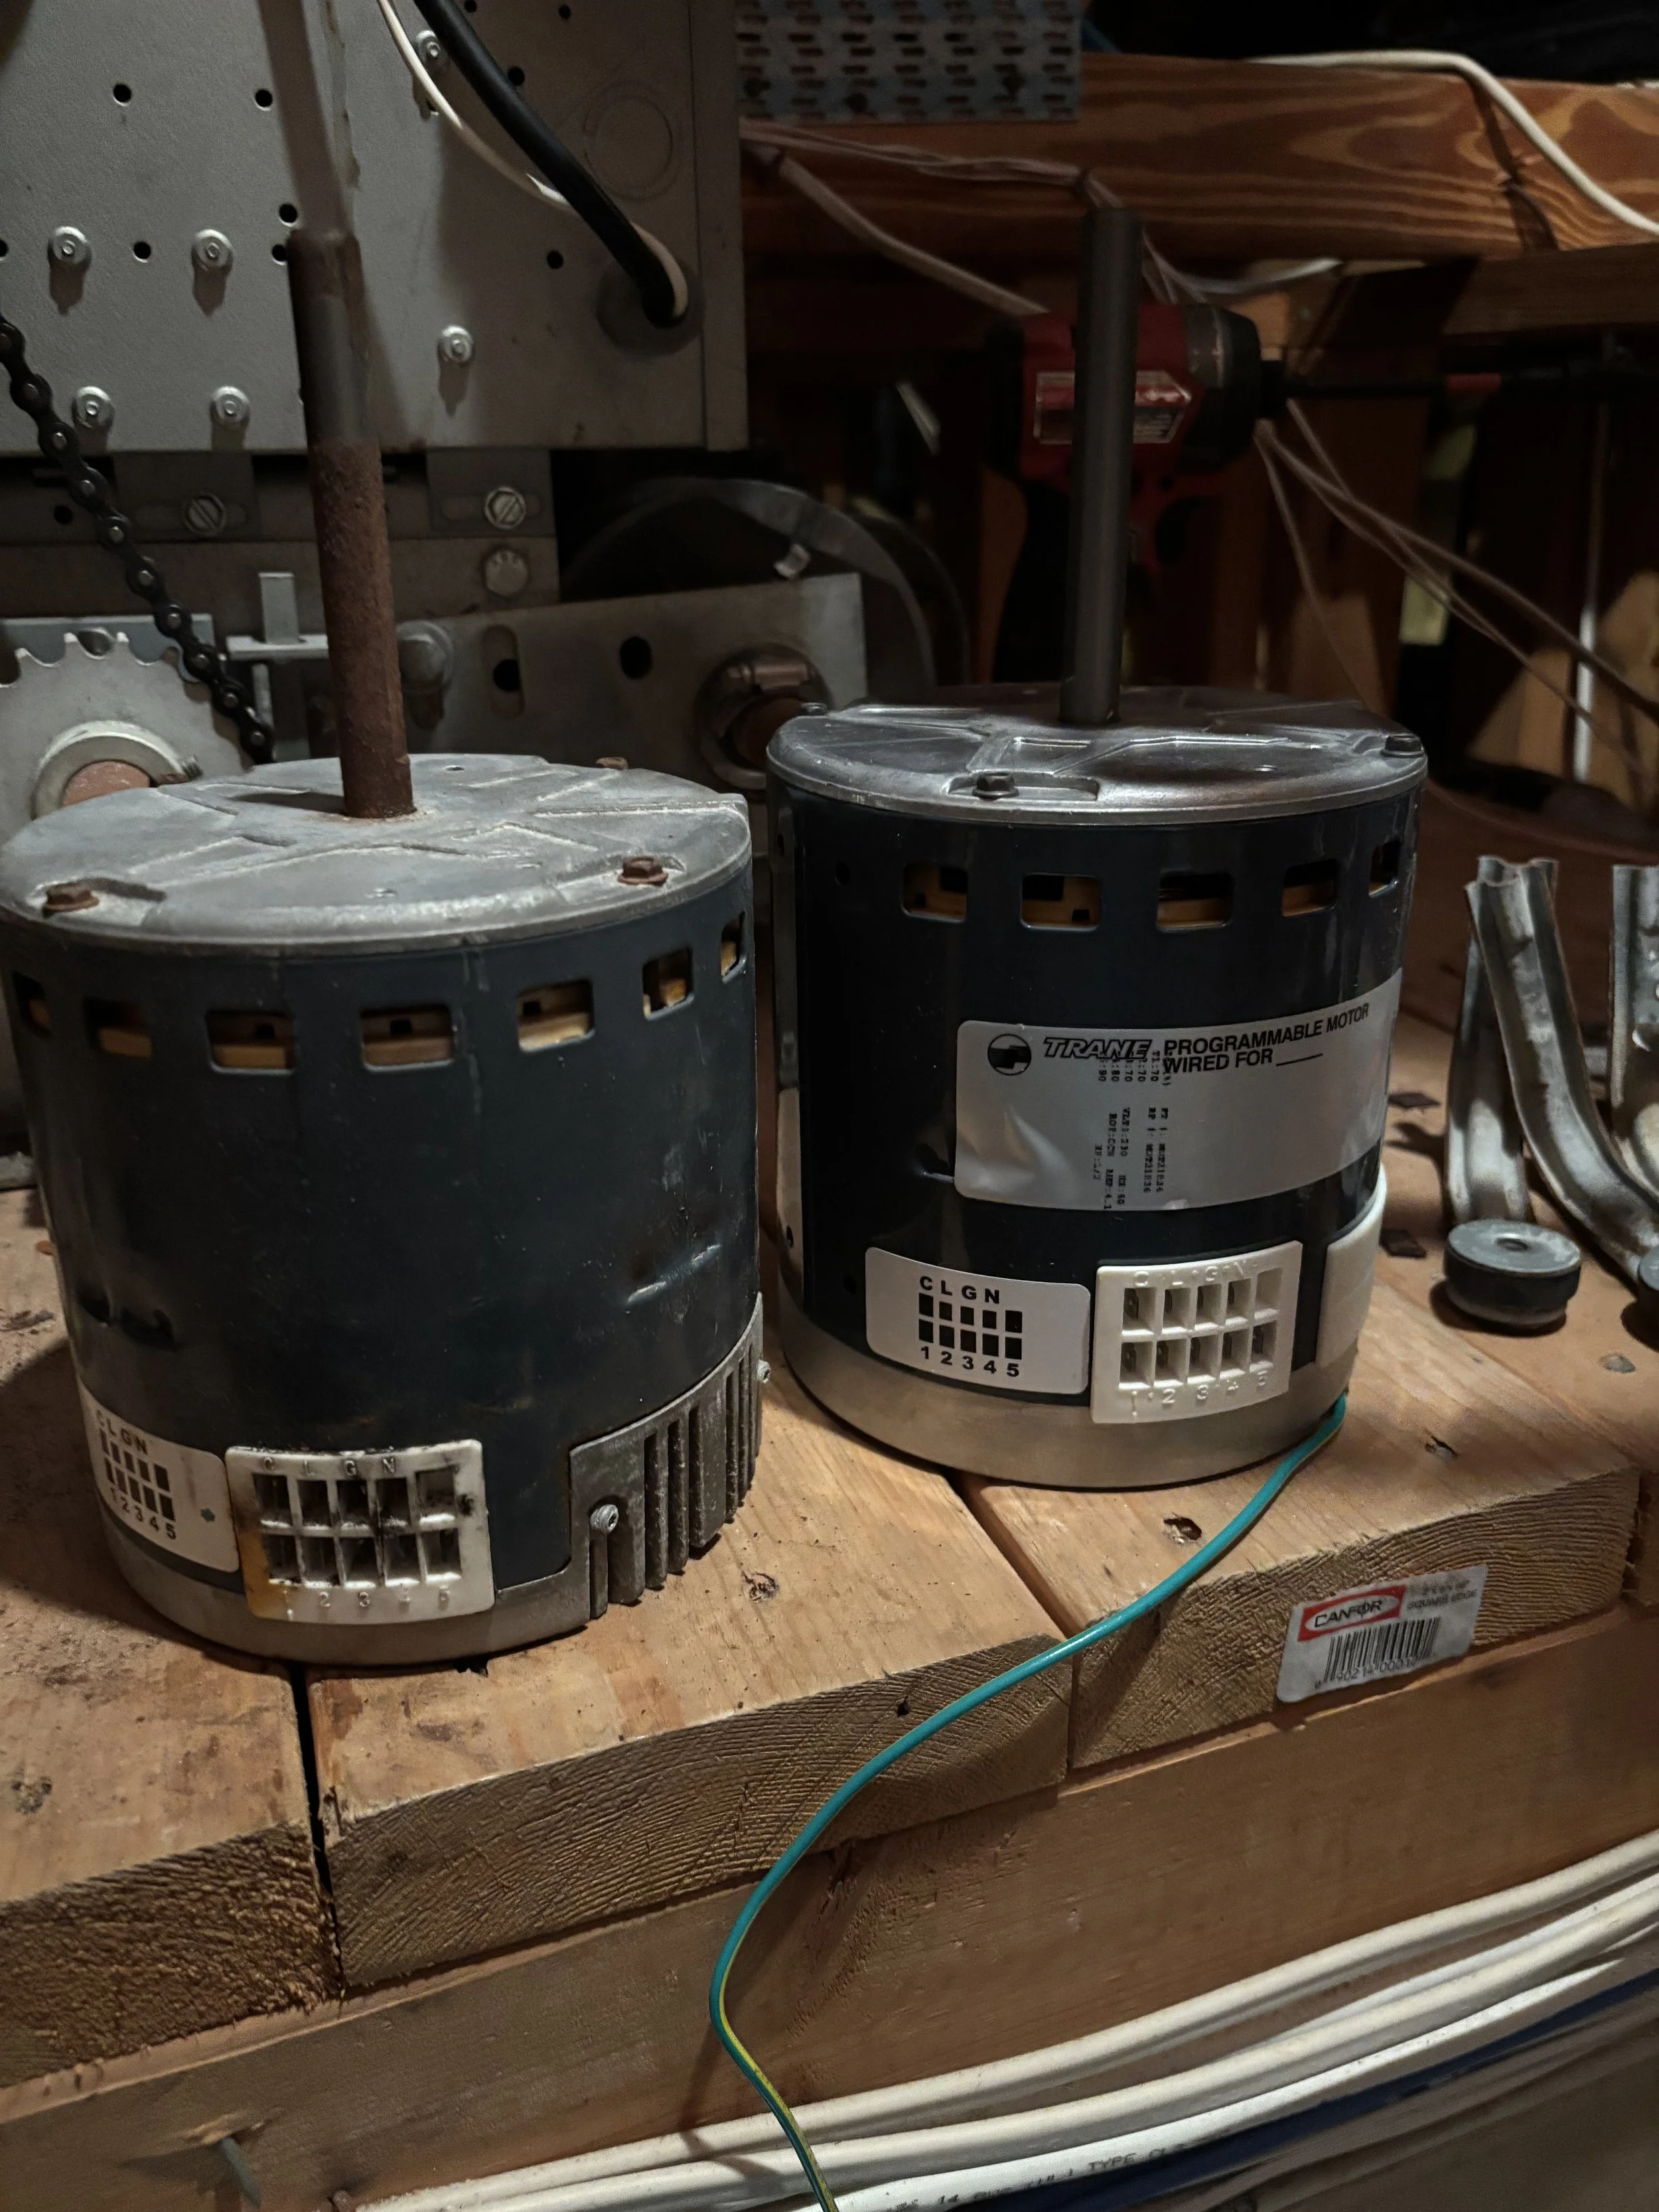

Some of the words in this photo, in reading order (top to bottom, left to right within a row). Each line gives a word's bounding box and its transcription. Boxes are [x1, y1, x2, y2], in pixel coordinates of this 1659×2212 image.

[1043, 1037, 1153, 1059] TRANE
[1163, 1019, 1323, 1057] PROGRAMMABLE
[1327, 1003, 1370, 1033] MOTOR
[1162, 1055, 1229, 1074] WIRED
[1236, 1048, 1273, 1068] FOR
[1315, 1598, 1382, 1628] CANFOR
